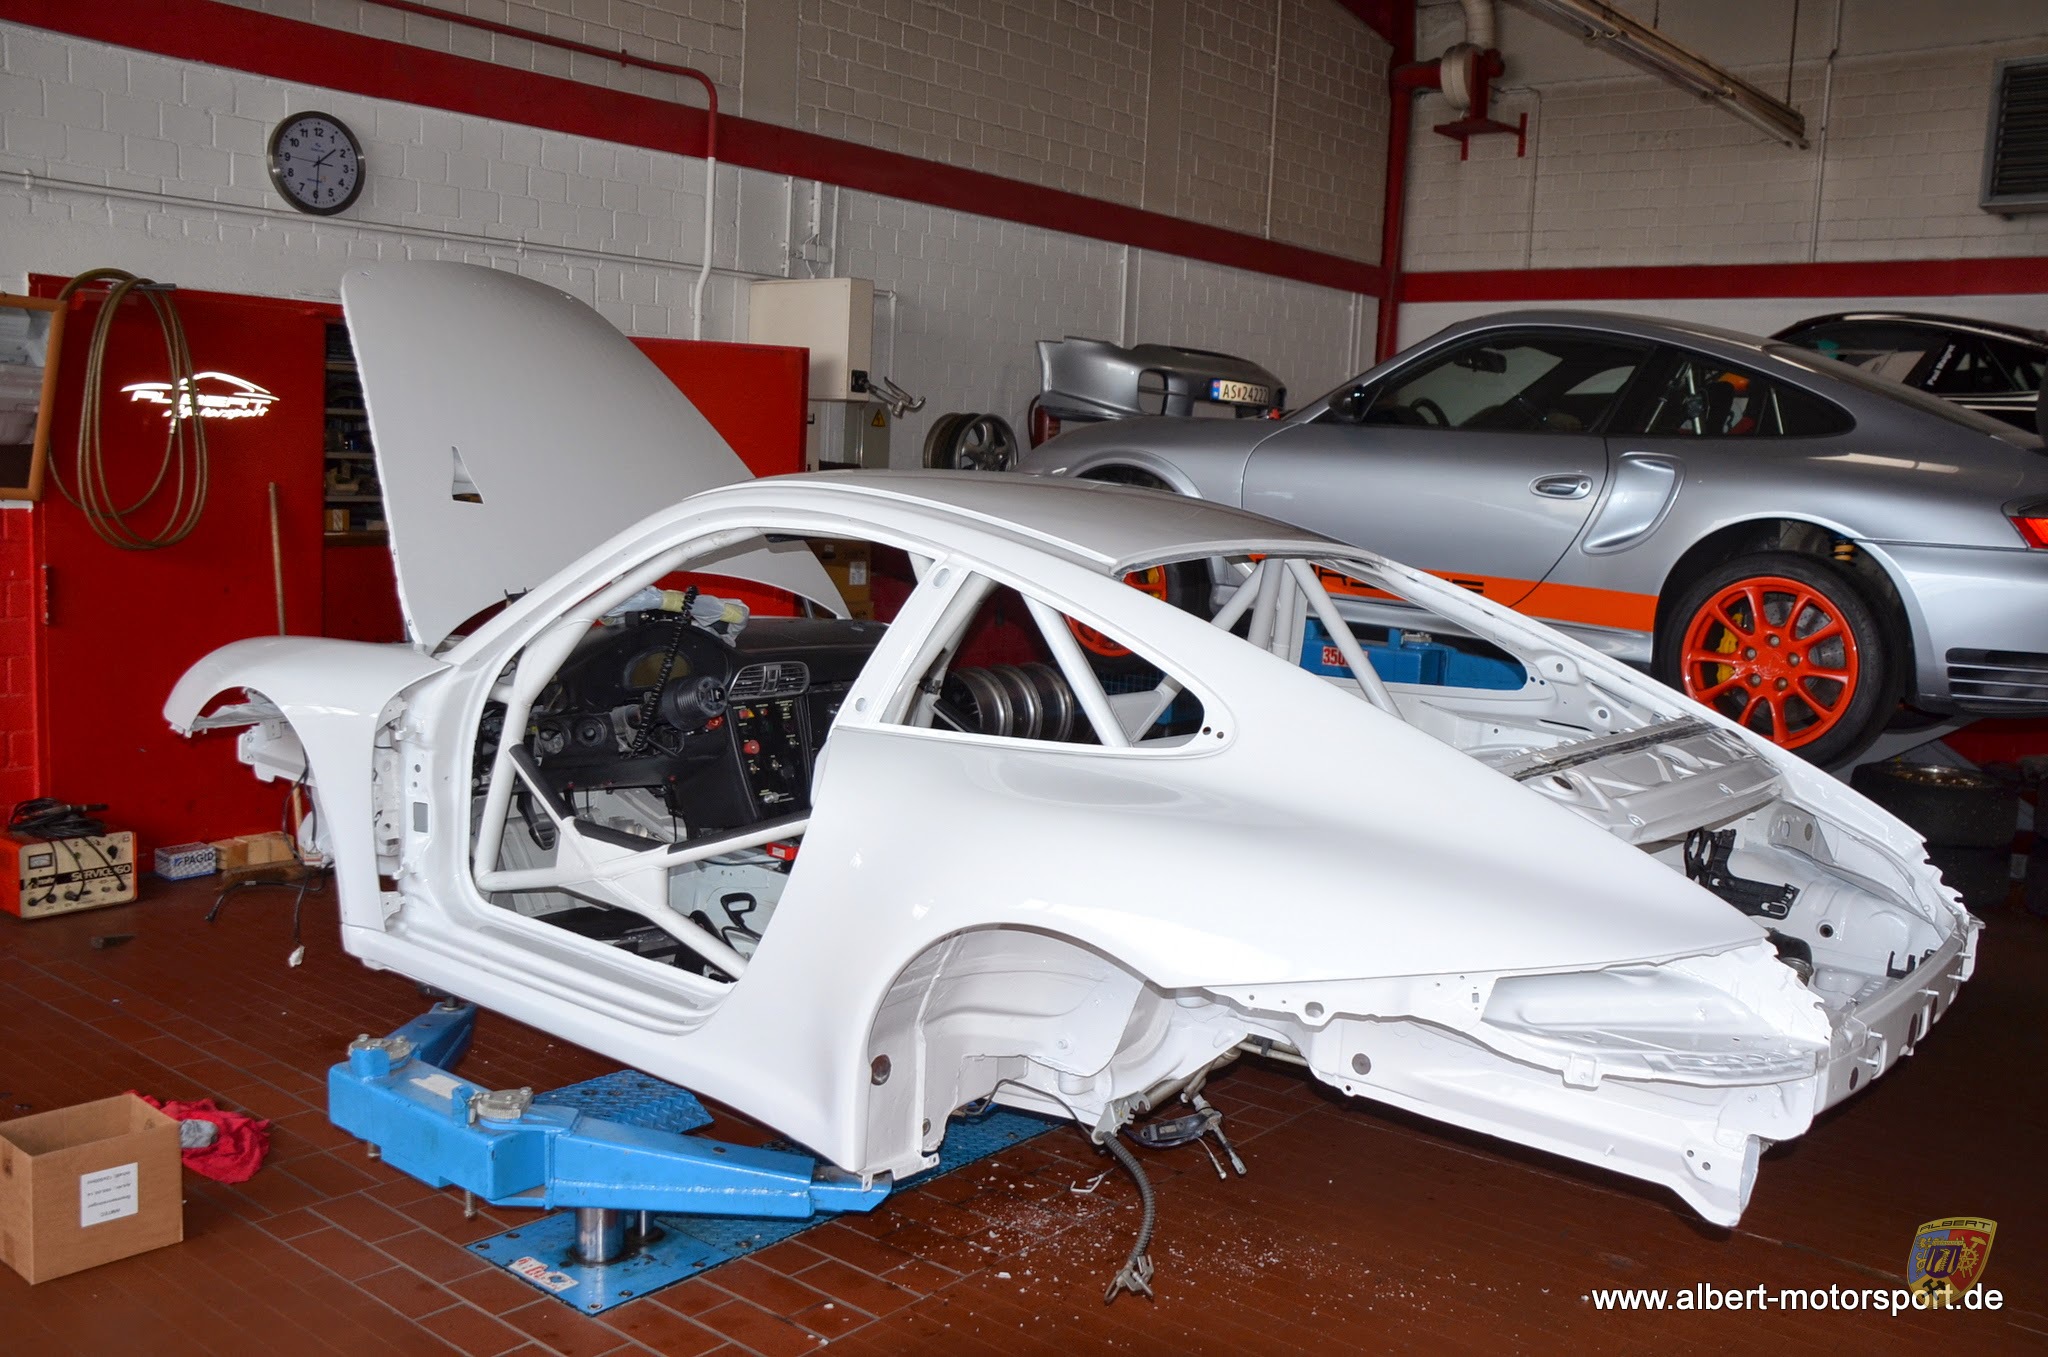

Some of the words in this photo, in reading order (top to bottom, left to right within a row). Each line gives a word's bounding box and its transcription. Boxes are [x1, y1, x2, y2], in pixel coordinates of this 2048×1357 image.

[300, 128, 308, 138] 11
[314, 127, 324, 137] 12
[289, 138, 300, 147] 10
[330, 135, 335, 144] 1
[284, 152, 291, 161] 9
[340, 149, 346, 158] 2
[287, 168, 294, 177] 8
[343, 165, 349, 173] 3
[299, 182, 305, 191] 7
[338, 178, 344, 187] 4
[313, 189, 319, 199] 6
[328, 188, 334, 197] 5
[1222, 383, 1237, 399] AS
[184, 851, 215, 865] PAGID
